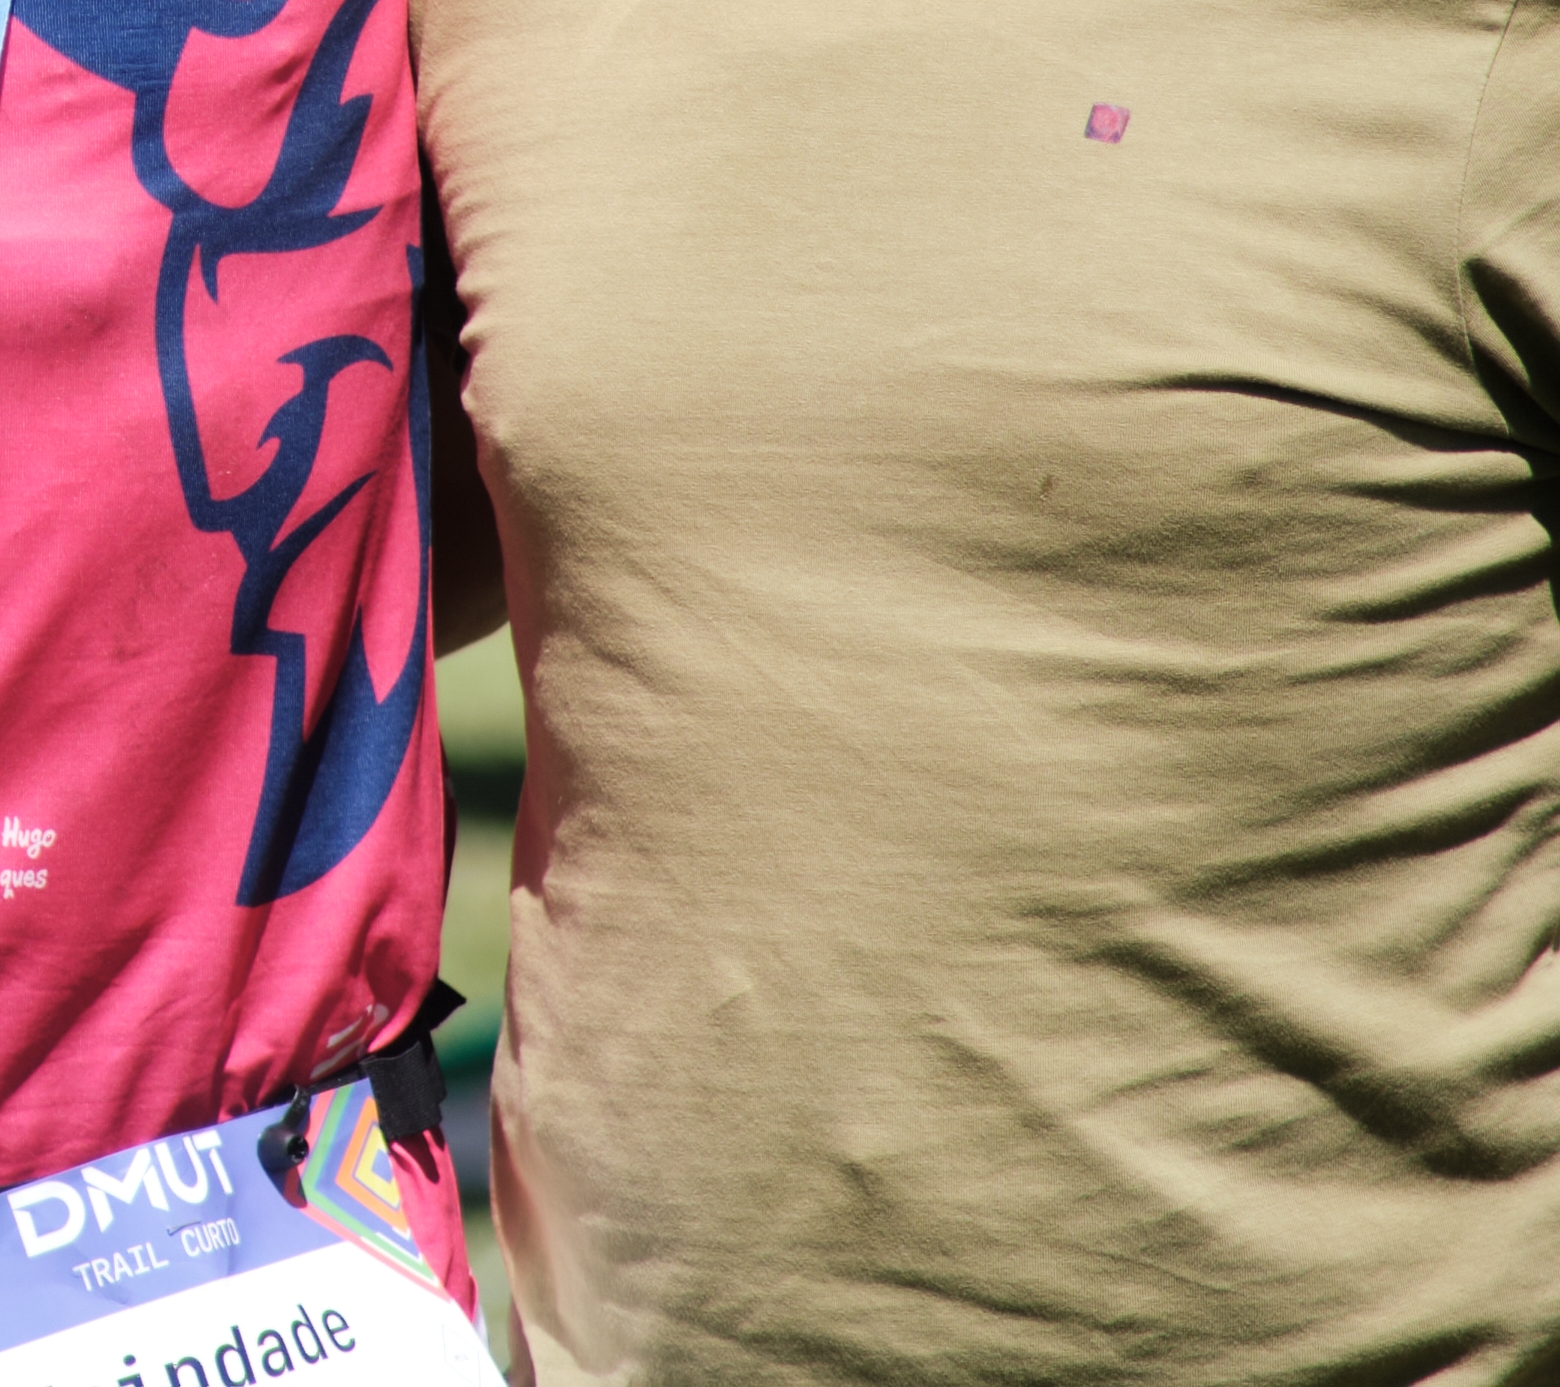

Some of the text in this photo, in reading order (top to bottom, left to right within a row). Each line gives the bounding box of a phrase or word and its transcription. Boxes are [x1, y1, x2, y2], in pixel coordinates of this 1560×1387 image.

[1, 817, 57, 859] Hugo
[7, 1129, 235, 1259] DMUT
[71, 1216, 242, 1294] TRAIL CURTO
[114, 1303, 357, 1387] indade
